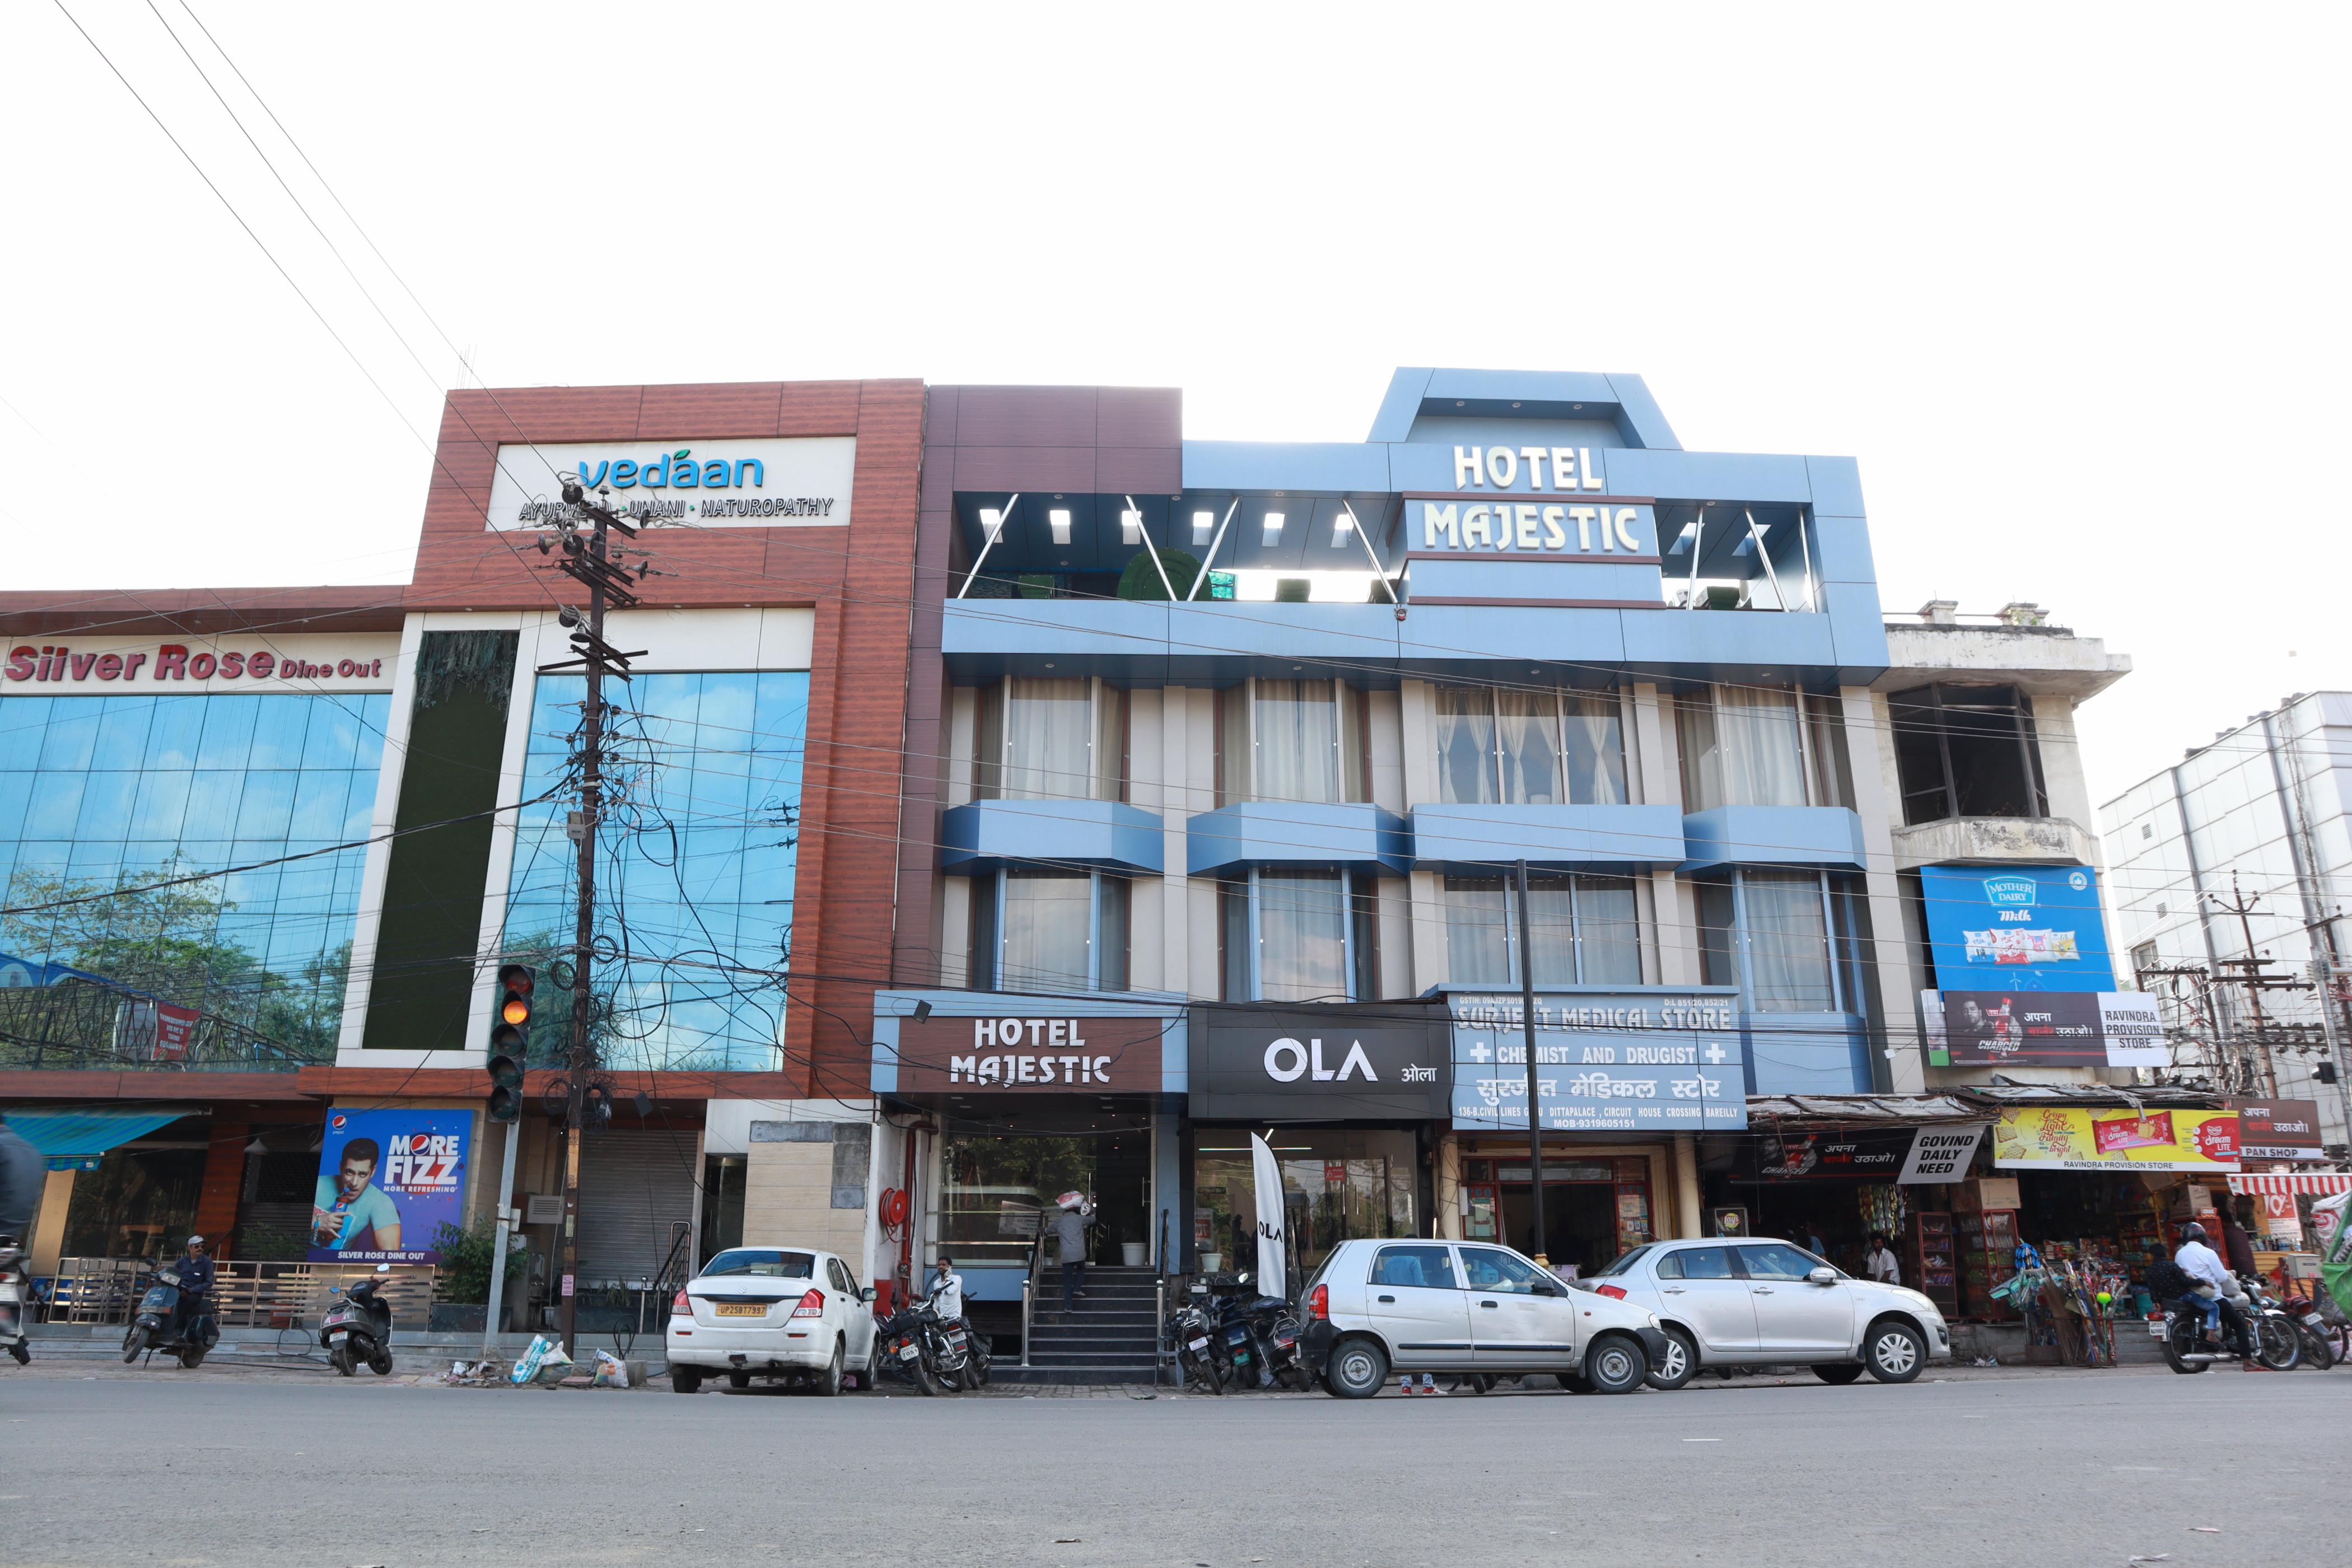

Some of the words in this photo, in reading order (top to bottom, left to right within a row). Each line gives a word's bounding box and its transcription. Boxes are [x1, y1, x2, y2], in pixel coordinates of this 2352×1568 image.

[579, 454, 763, 489] vedaan
[1454, 445, 1603, 491] HOTEL
[701, 498, 833, 517] NATUROPATHY
[1424, 503, 1640, 552] MAJESTIC
[5, 646, 146, 681] Silver
[155, 645, 274, 680] Rose
[280, 660, 333, 678] Dine
[337, 658, 381, 678] Out
[1989, 883, 2032, 894] MOTHER
[1999, 893, 2027, 901] DAIRY
[1458, 1007, 1551, 1035] SURJET
[1561, 1007, 1653, 1033] MEDICAL
[1660, 1007, 1731, 1033] STORE
[2024, 1012, 2052, 1023] अपना
[2105, 1011, 2156, 1023] RAVINDRA
[974, 1018, 1086, 1049] HOTEL
[2106, 1024, 2160, 1035] PROVISION
[2119, 1037, 2152, 1049] STORE
[1264, 1038, 1379, 1082] OLA
[1582, 1047, 1615, 1063] AND
[1627, 1047, 1696, 1064] DRUGIST
[950, 1055, 1112, 1088] MAJESTIC
[1401, 1063, 1438, 1082] ओला
[1570, 1072, 1658, 1099] मेडिकल
[1670, 1073, 1721, 1098] स्टोर
[1501, 1107, 1521, 1117] LINES
[1524, 1107, 1543, 1117] GU
[1604, 1107, 1632, 1117] CIRCUIT
[1639, 1107, 1662, 1118] HOUSE
[1667, 1107, 1701, 1118] CROSSING
[1706, 1108, 1737, 1118] BAREILLY
[2244, 1108, 2270, 1117] अपना
[1554, 1119, 1635, 1128] MOB-9319605151
[388, 1135, 459, 1155] MORE
[1919, 1135, 1975, 1147] GOVIND
[1920, 1149, 1962, 1160] DAILY
[384, 1156, 459, 1185] FIZZ
[1916, 1163, 1954, 1174] NEED
[1259, 1221, 1283, 1243] OLA
[338, 1250, 363, 1259] SILVER
[365, 1251, 386, 1259] ROSE
[388, 1252, 407, 1260] DINE
[721, 1305, 766, 1314] UP25BT7997
[902, 1347, 918, 1358] 7051
